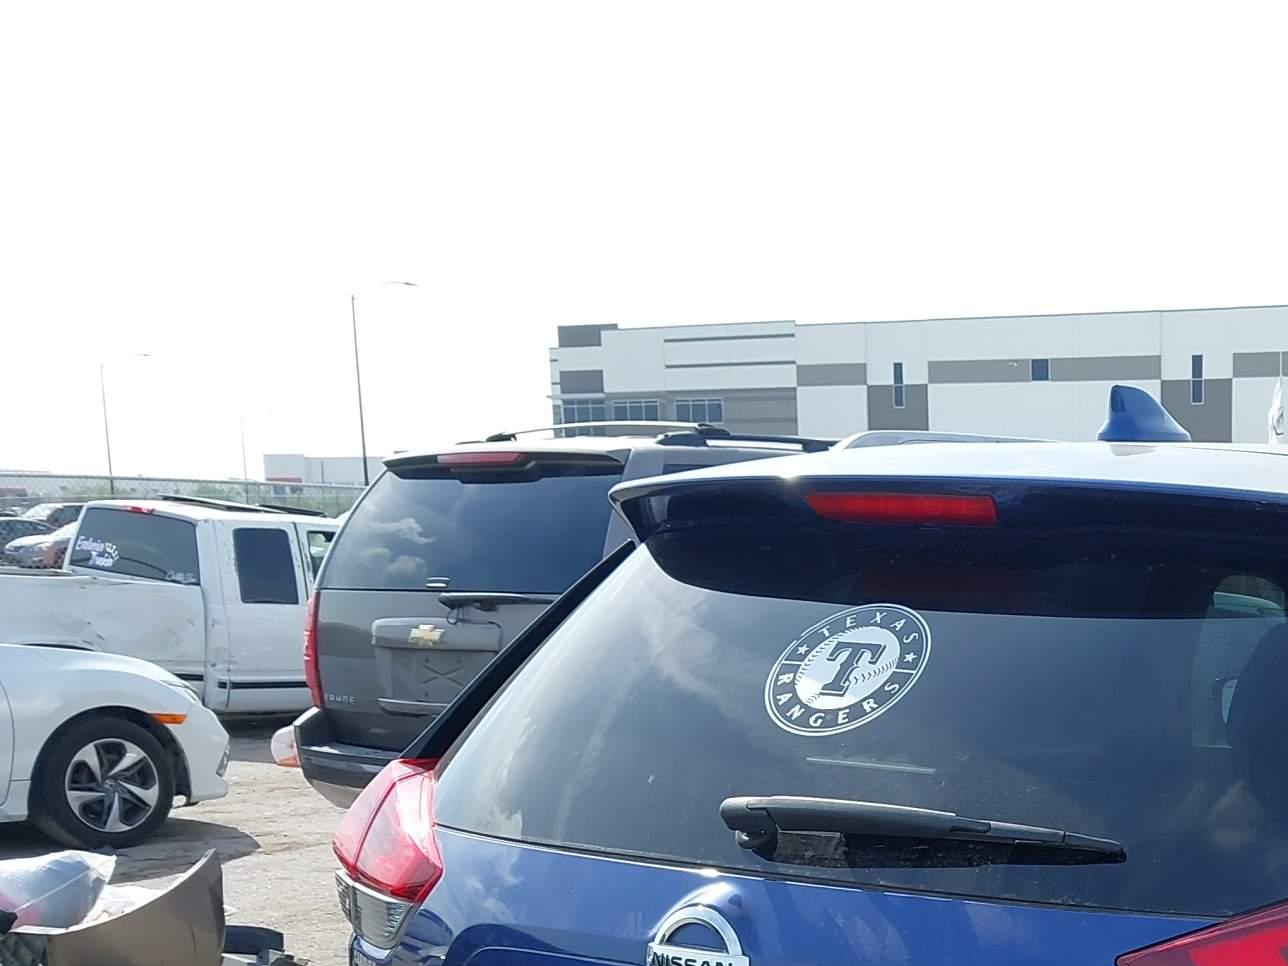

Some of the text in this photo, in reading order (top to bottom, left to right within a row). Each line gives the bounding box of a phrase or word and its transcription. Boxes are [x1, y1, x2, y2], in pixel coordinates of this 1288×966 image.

[818, 612, 918, 643] TEXAS
[819, 641, 886, 697] T
[777, 673, 899, 727] RANGERS
